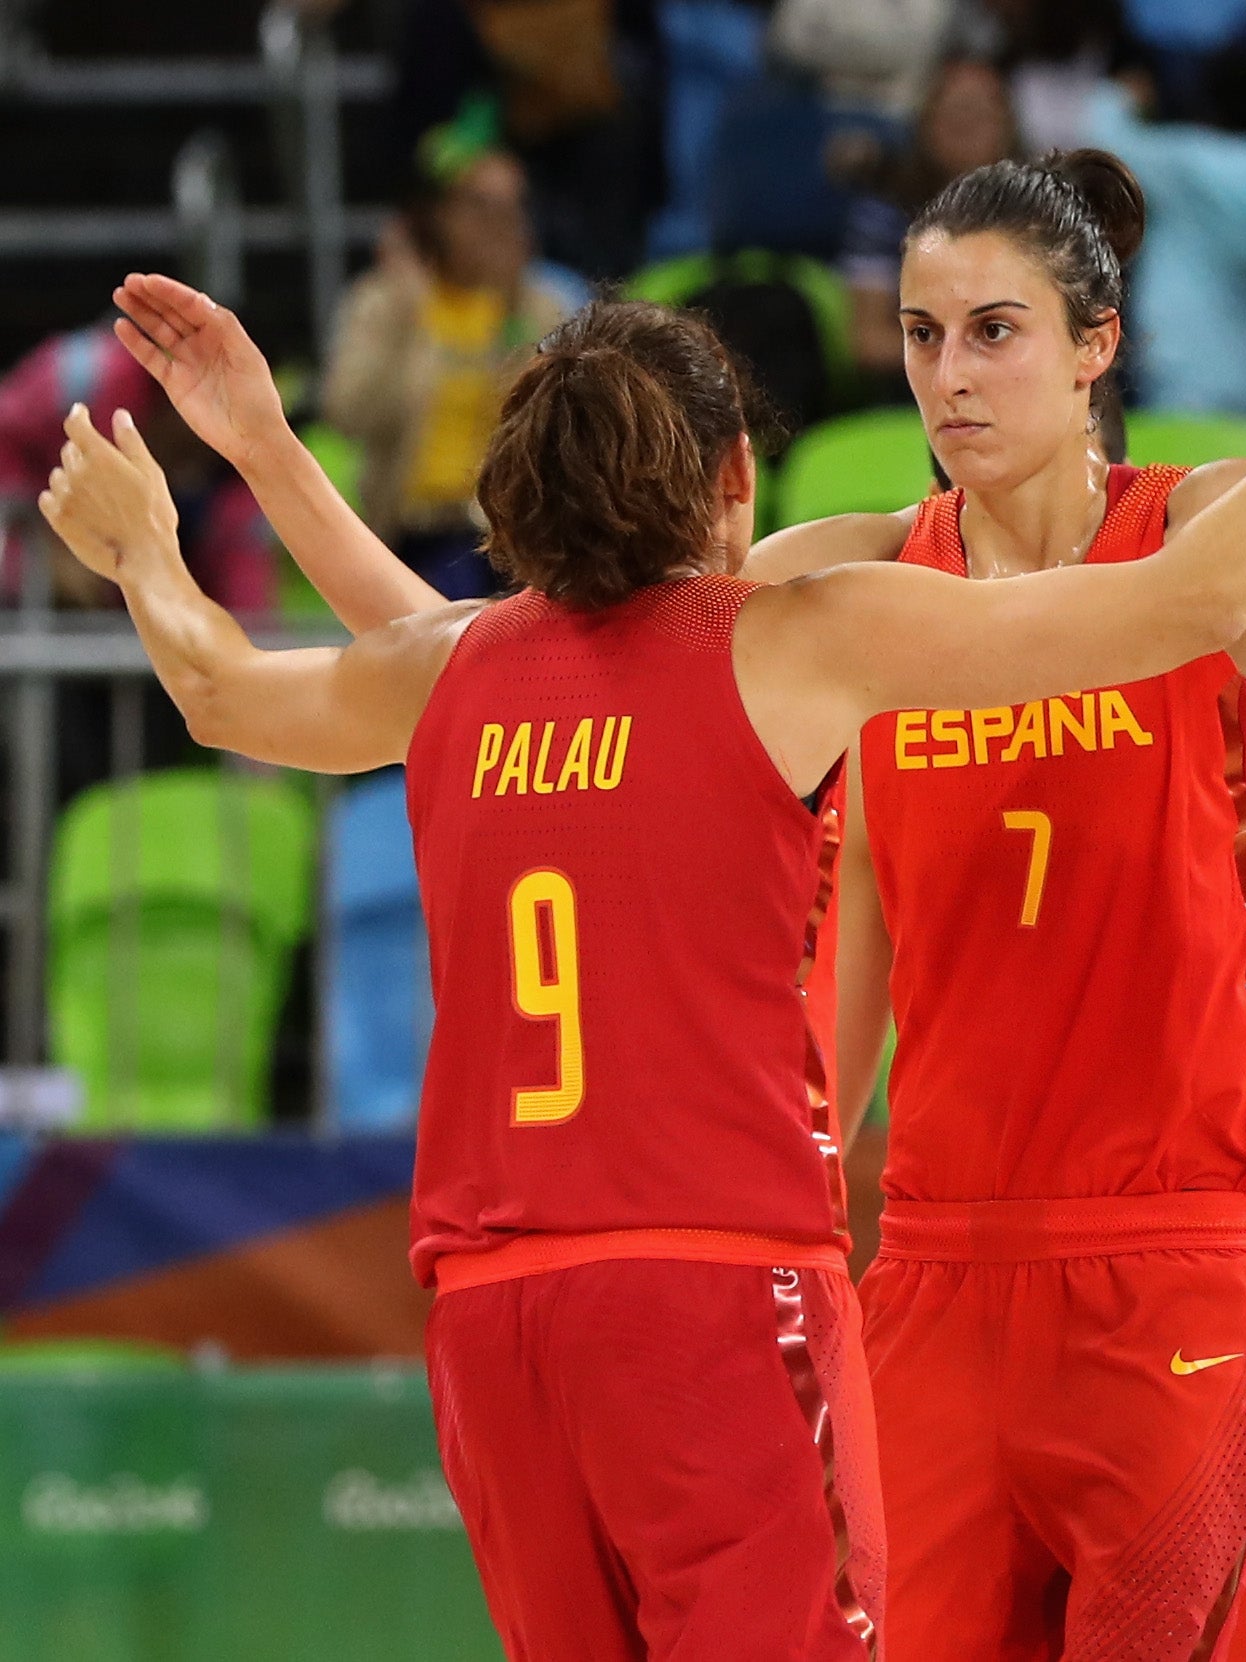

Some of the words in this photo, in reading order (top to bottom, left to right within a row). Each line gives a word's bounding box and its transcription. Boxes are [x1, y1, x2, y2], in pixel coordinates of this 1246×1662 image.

[472, 715, 632, 799] PALAU
[895, 690, 1153, 770] ESPAÑA
[1003, 809, 1054, 928] 7
[509, 868, 586, 1127] 9
